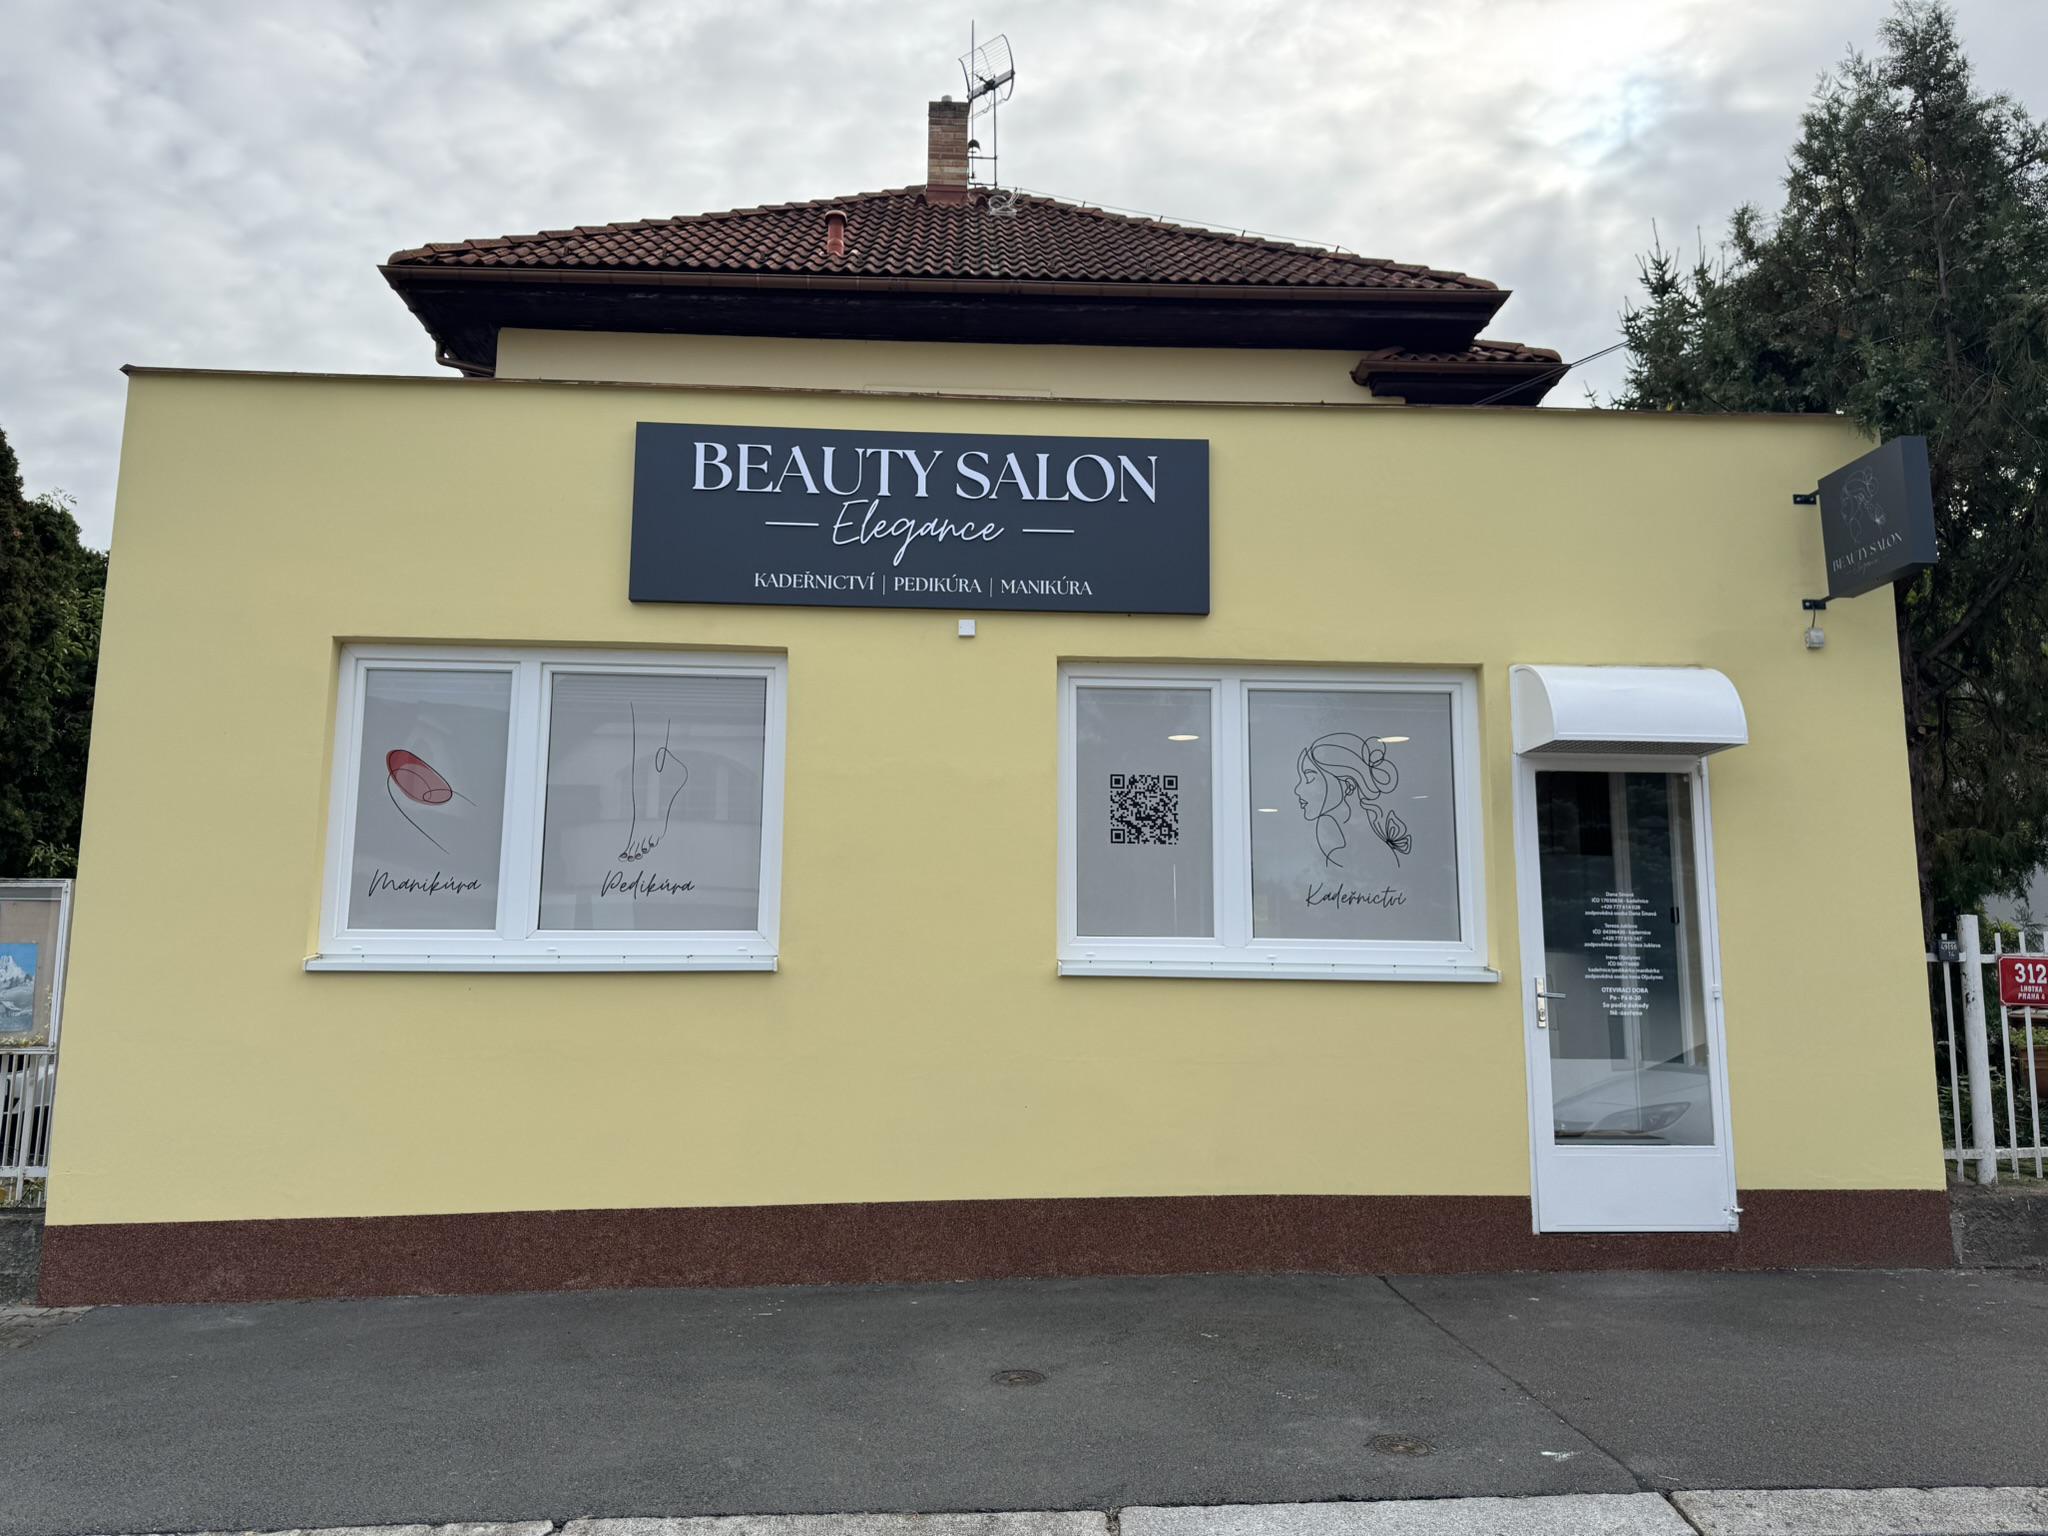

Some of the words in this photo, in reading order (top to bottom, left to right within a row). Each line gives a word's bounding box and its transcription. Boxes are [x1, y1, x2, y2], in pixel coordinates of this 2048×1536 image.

[692, 441, 943, 498] BEAUTY
[956, 451, 1158, 503] SALON
[832, 498, 1004, 566] Elegance
[1832, 546, 1868, 572] BEAUTY
[1869, 531, 1903, 555] SALON
[754, 571, 875, 591] KADEŘNICTVÍ
[894, 573, 982, 593] PEDIKÚRA
[1001, 576, 1093, 596] MANIKÚRA
[368, 869, 482, 897] Manikúra
[600, 870, 695, 900] Pedikúra
[2014, 963, 2048, 984] 312
[2020, 985, 2043, 993] LHOTKA
